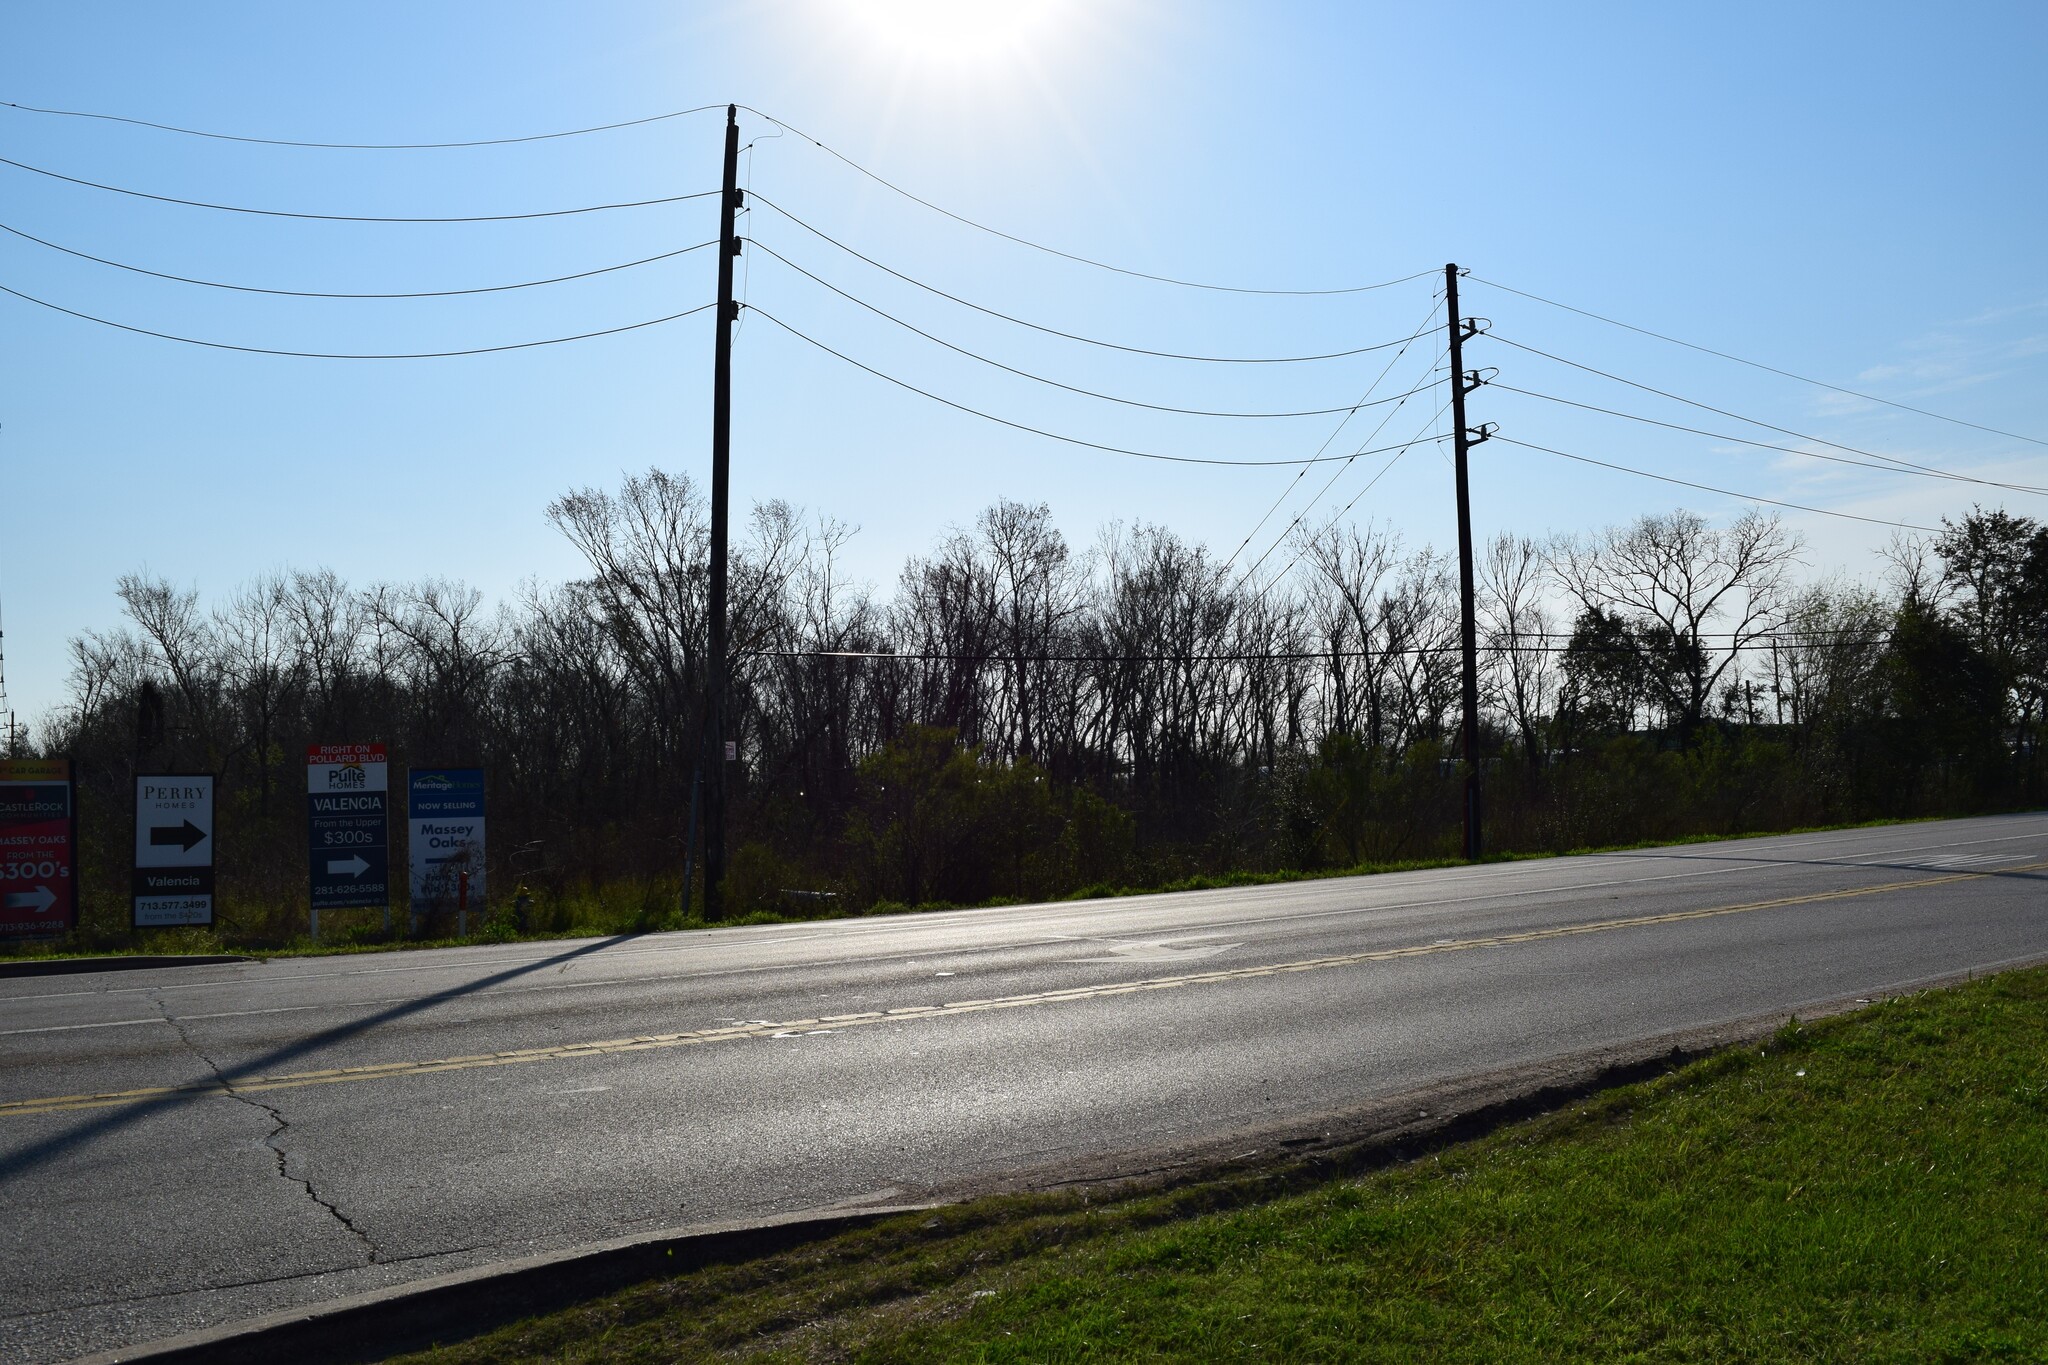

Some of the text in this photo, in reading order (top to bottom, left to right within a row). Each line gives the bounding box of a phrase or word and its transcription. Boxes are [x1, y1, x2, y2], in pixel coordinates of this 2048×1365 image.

[320, 745, 370, 754] RIGHT ON
[309, 753, 385, 763] POLLARD BLVD
[329, 768, 366, 782] Pulte
[144, 786, 207, 799] PERRY
[313, 796, 382, 811] VALENCIA
[418, 801, 476, 810] NOW SELLING
[315, 818, 382, 828] From the Upper
[421, 824, 474, 837] Massey
[38, 835, 67, 844] OAKS
[324, 830, 373, 845] $300s
[429, 836, 466, 848] Oaks
[7, 850, 55, 859] FROM THE
[147, 875, 200, 887] Valencia
[315, 883, 385, 895] 281-626-5588
[140, 900, 207, 911] 713.577.3499
